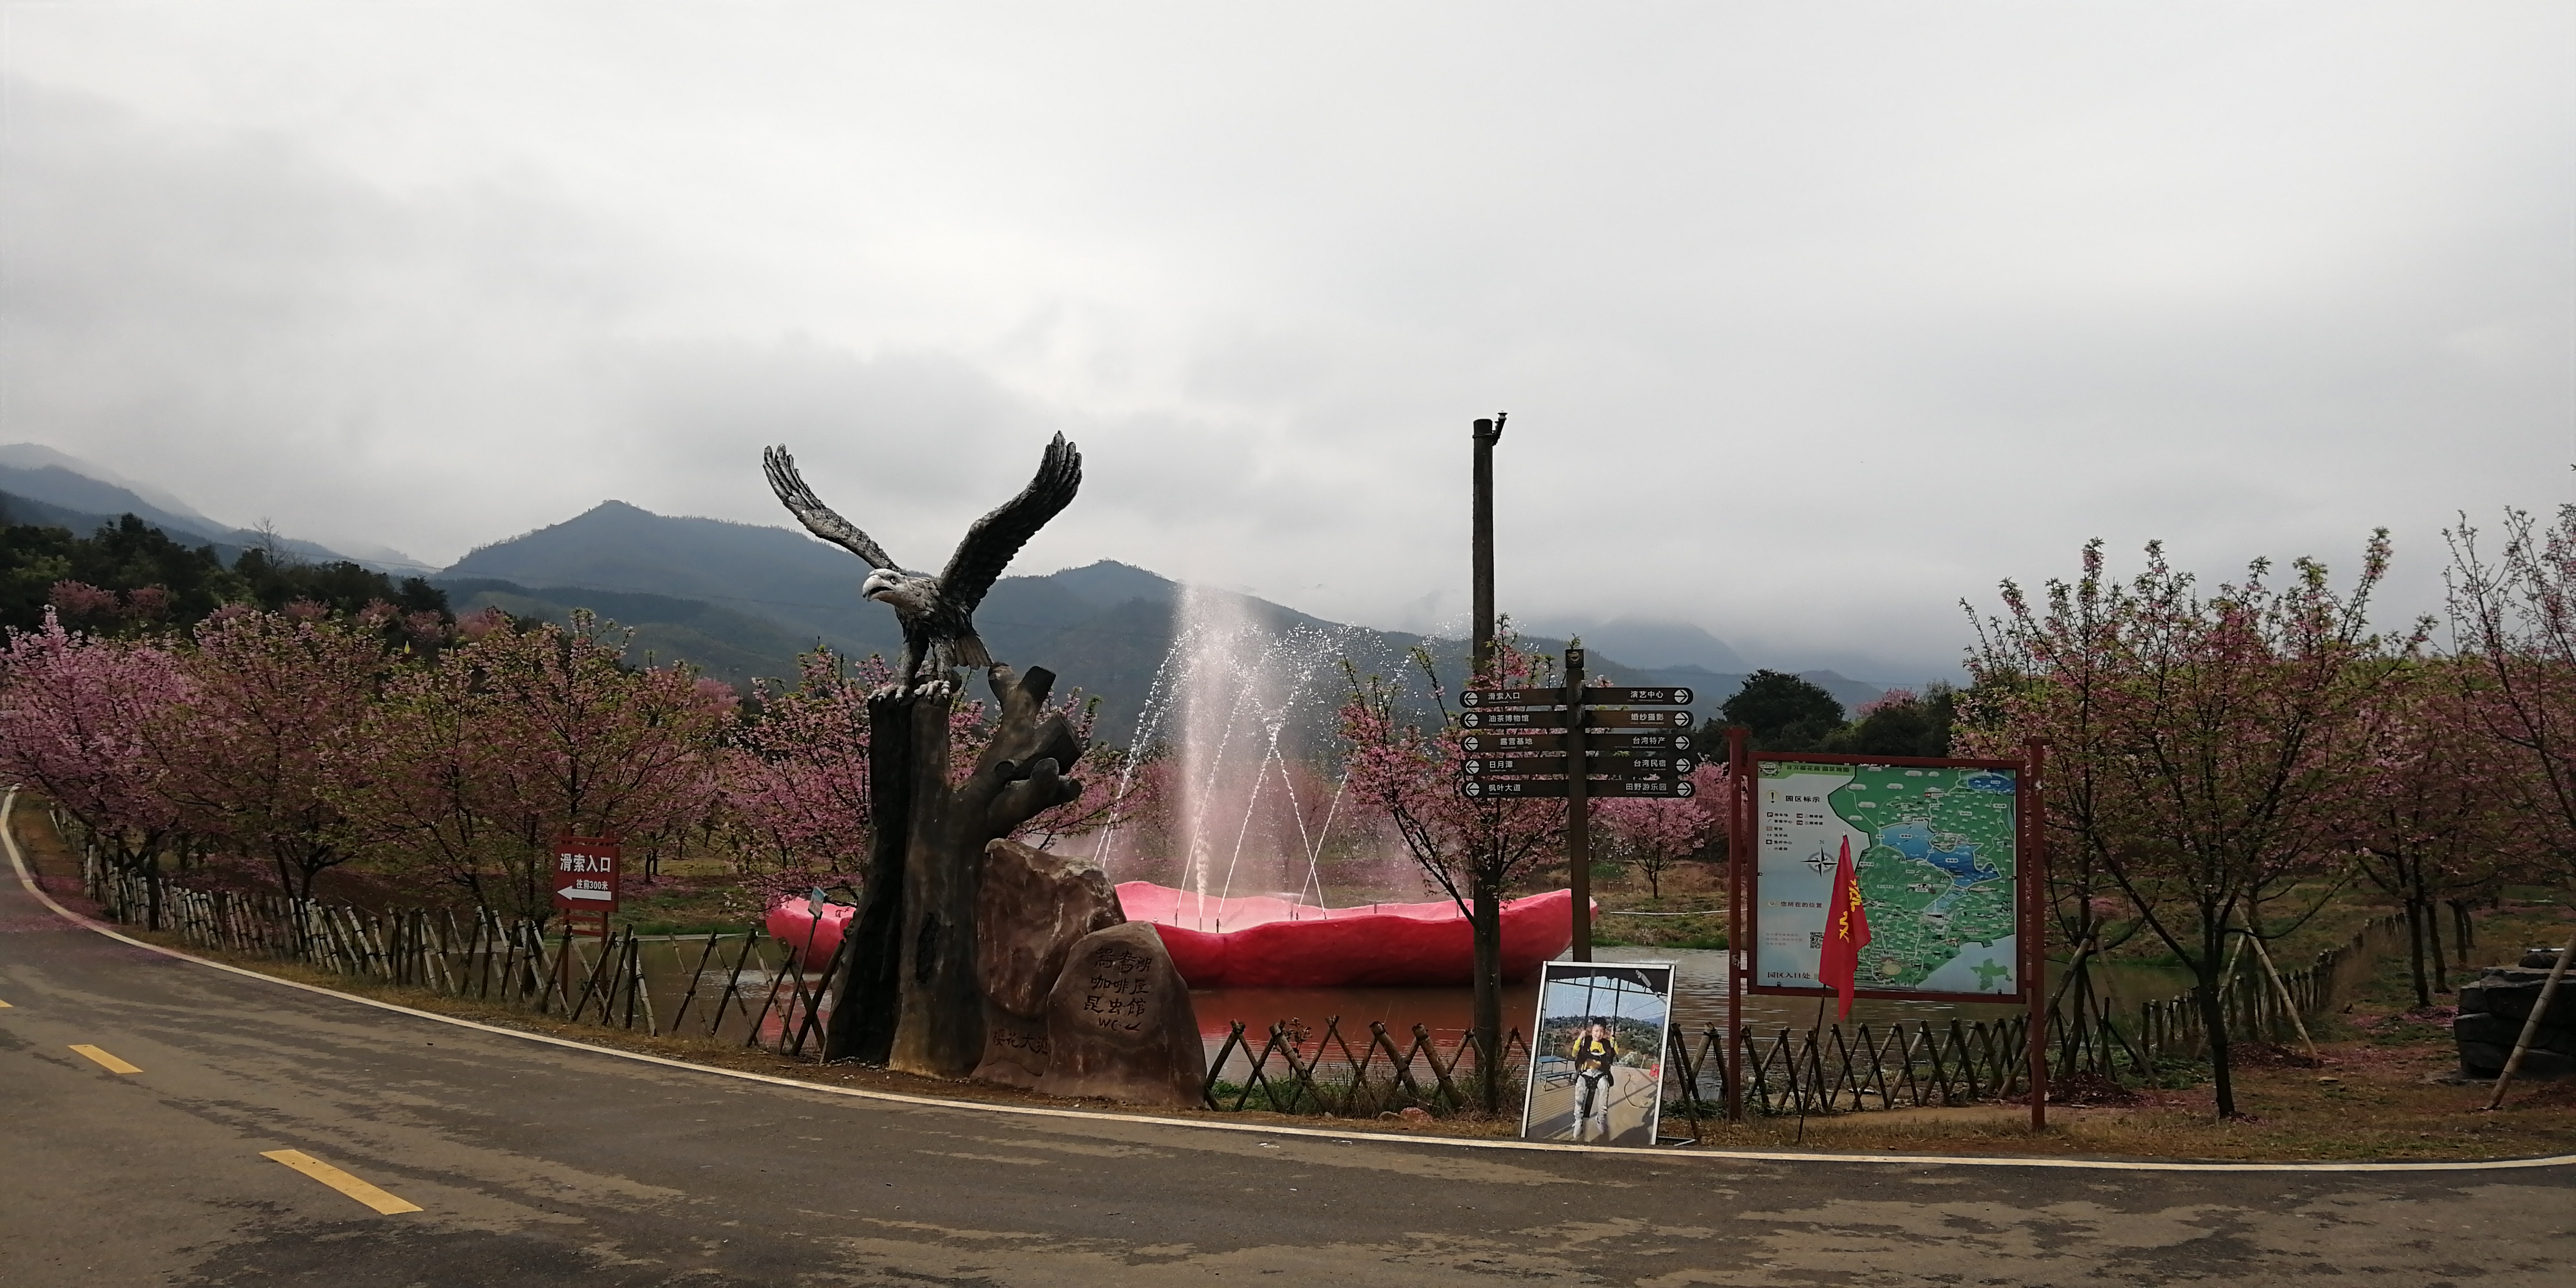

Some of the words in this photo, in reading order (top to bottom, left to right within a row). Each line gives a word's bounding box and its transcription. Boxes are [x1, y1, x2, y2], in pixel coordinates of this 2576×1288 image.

[1631, 690, 1664, 698] 演艺中心
[1632, 736, 1666, 745] 台湾特产
[1633, 759, 1666, 768] 台湾民宿
[560, 853, 610, 873] 滑索入口
[576, 879, 608, 891] 往前300米
[1091, 974, 1149, 995] 咖啡屋
